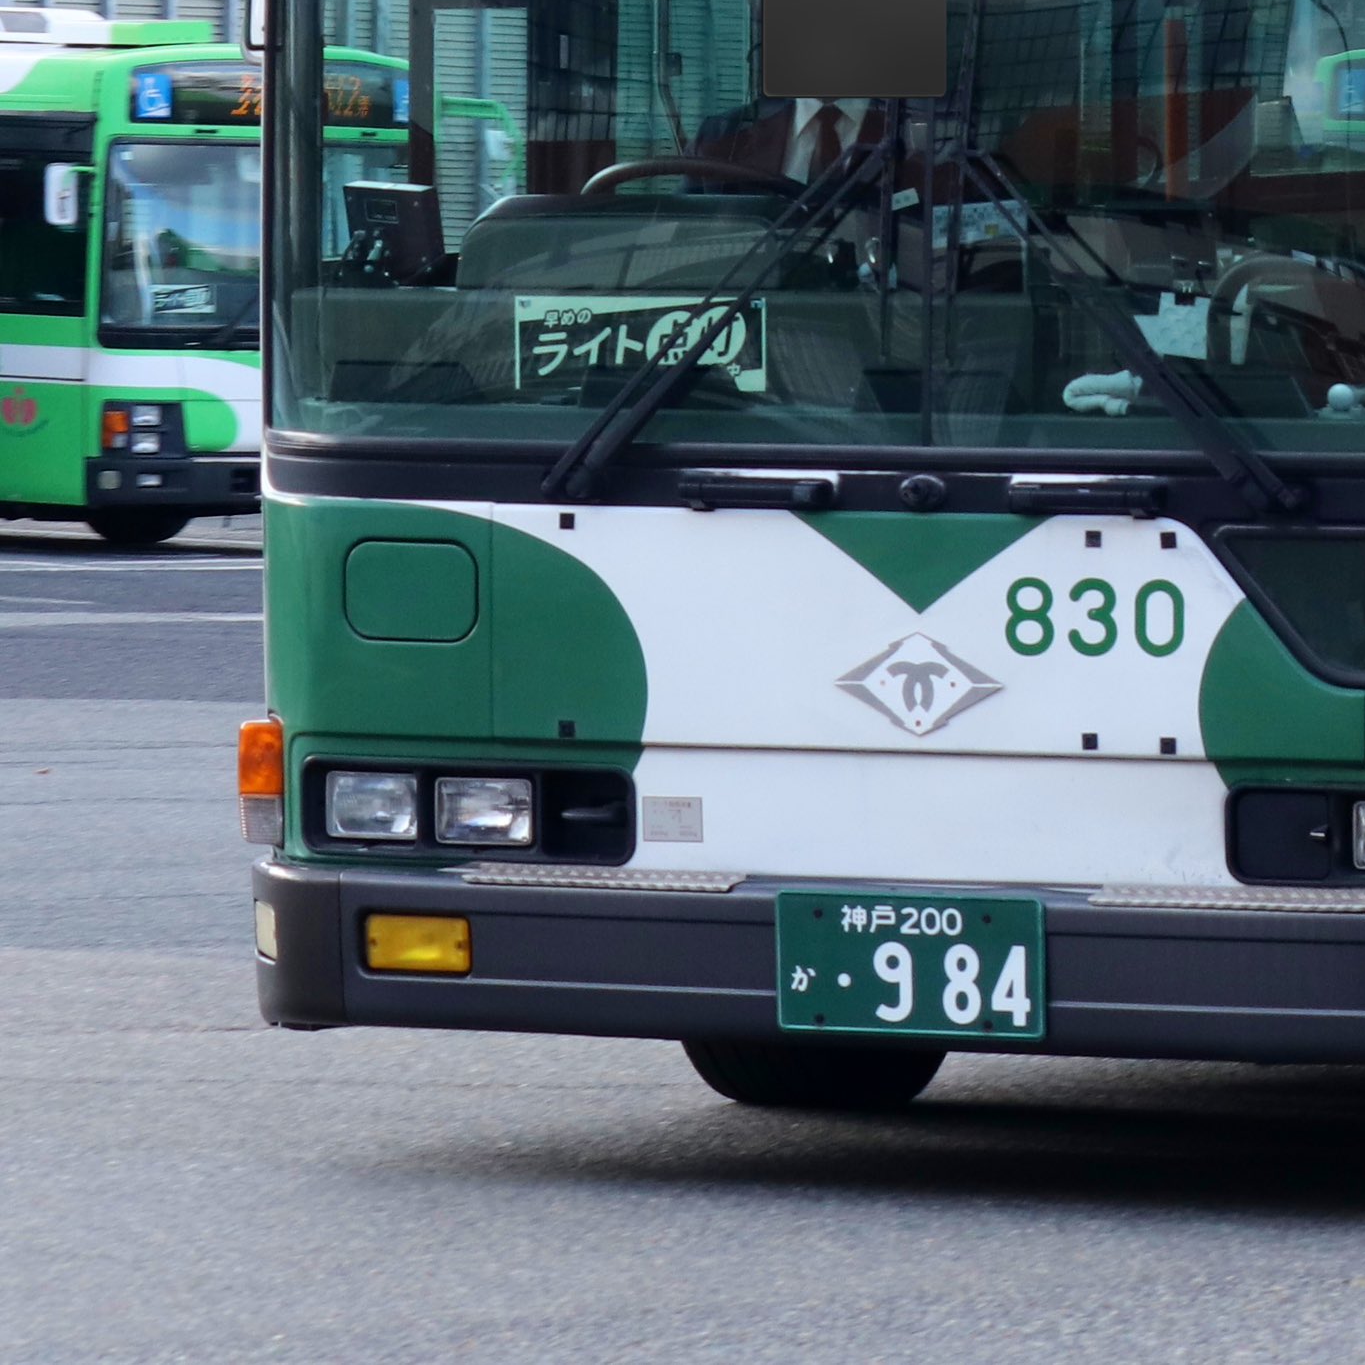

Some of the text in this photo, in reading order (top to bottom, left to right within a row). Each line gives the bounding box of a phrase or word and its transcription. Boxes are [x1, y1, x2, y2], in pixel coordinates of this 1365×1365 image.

[543, 308, 592, 328] 早めの
[1005, 577, 1185, 657] 830
[790, 964, 817, 992] か
